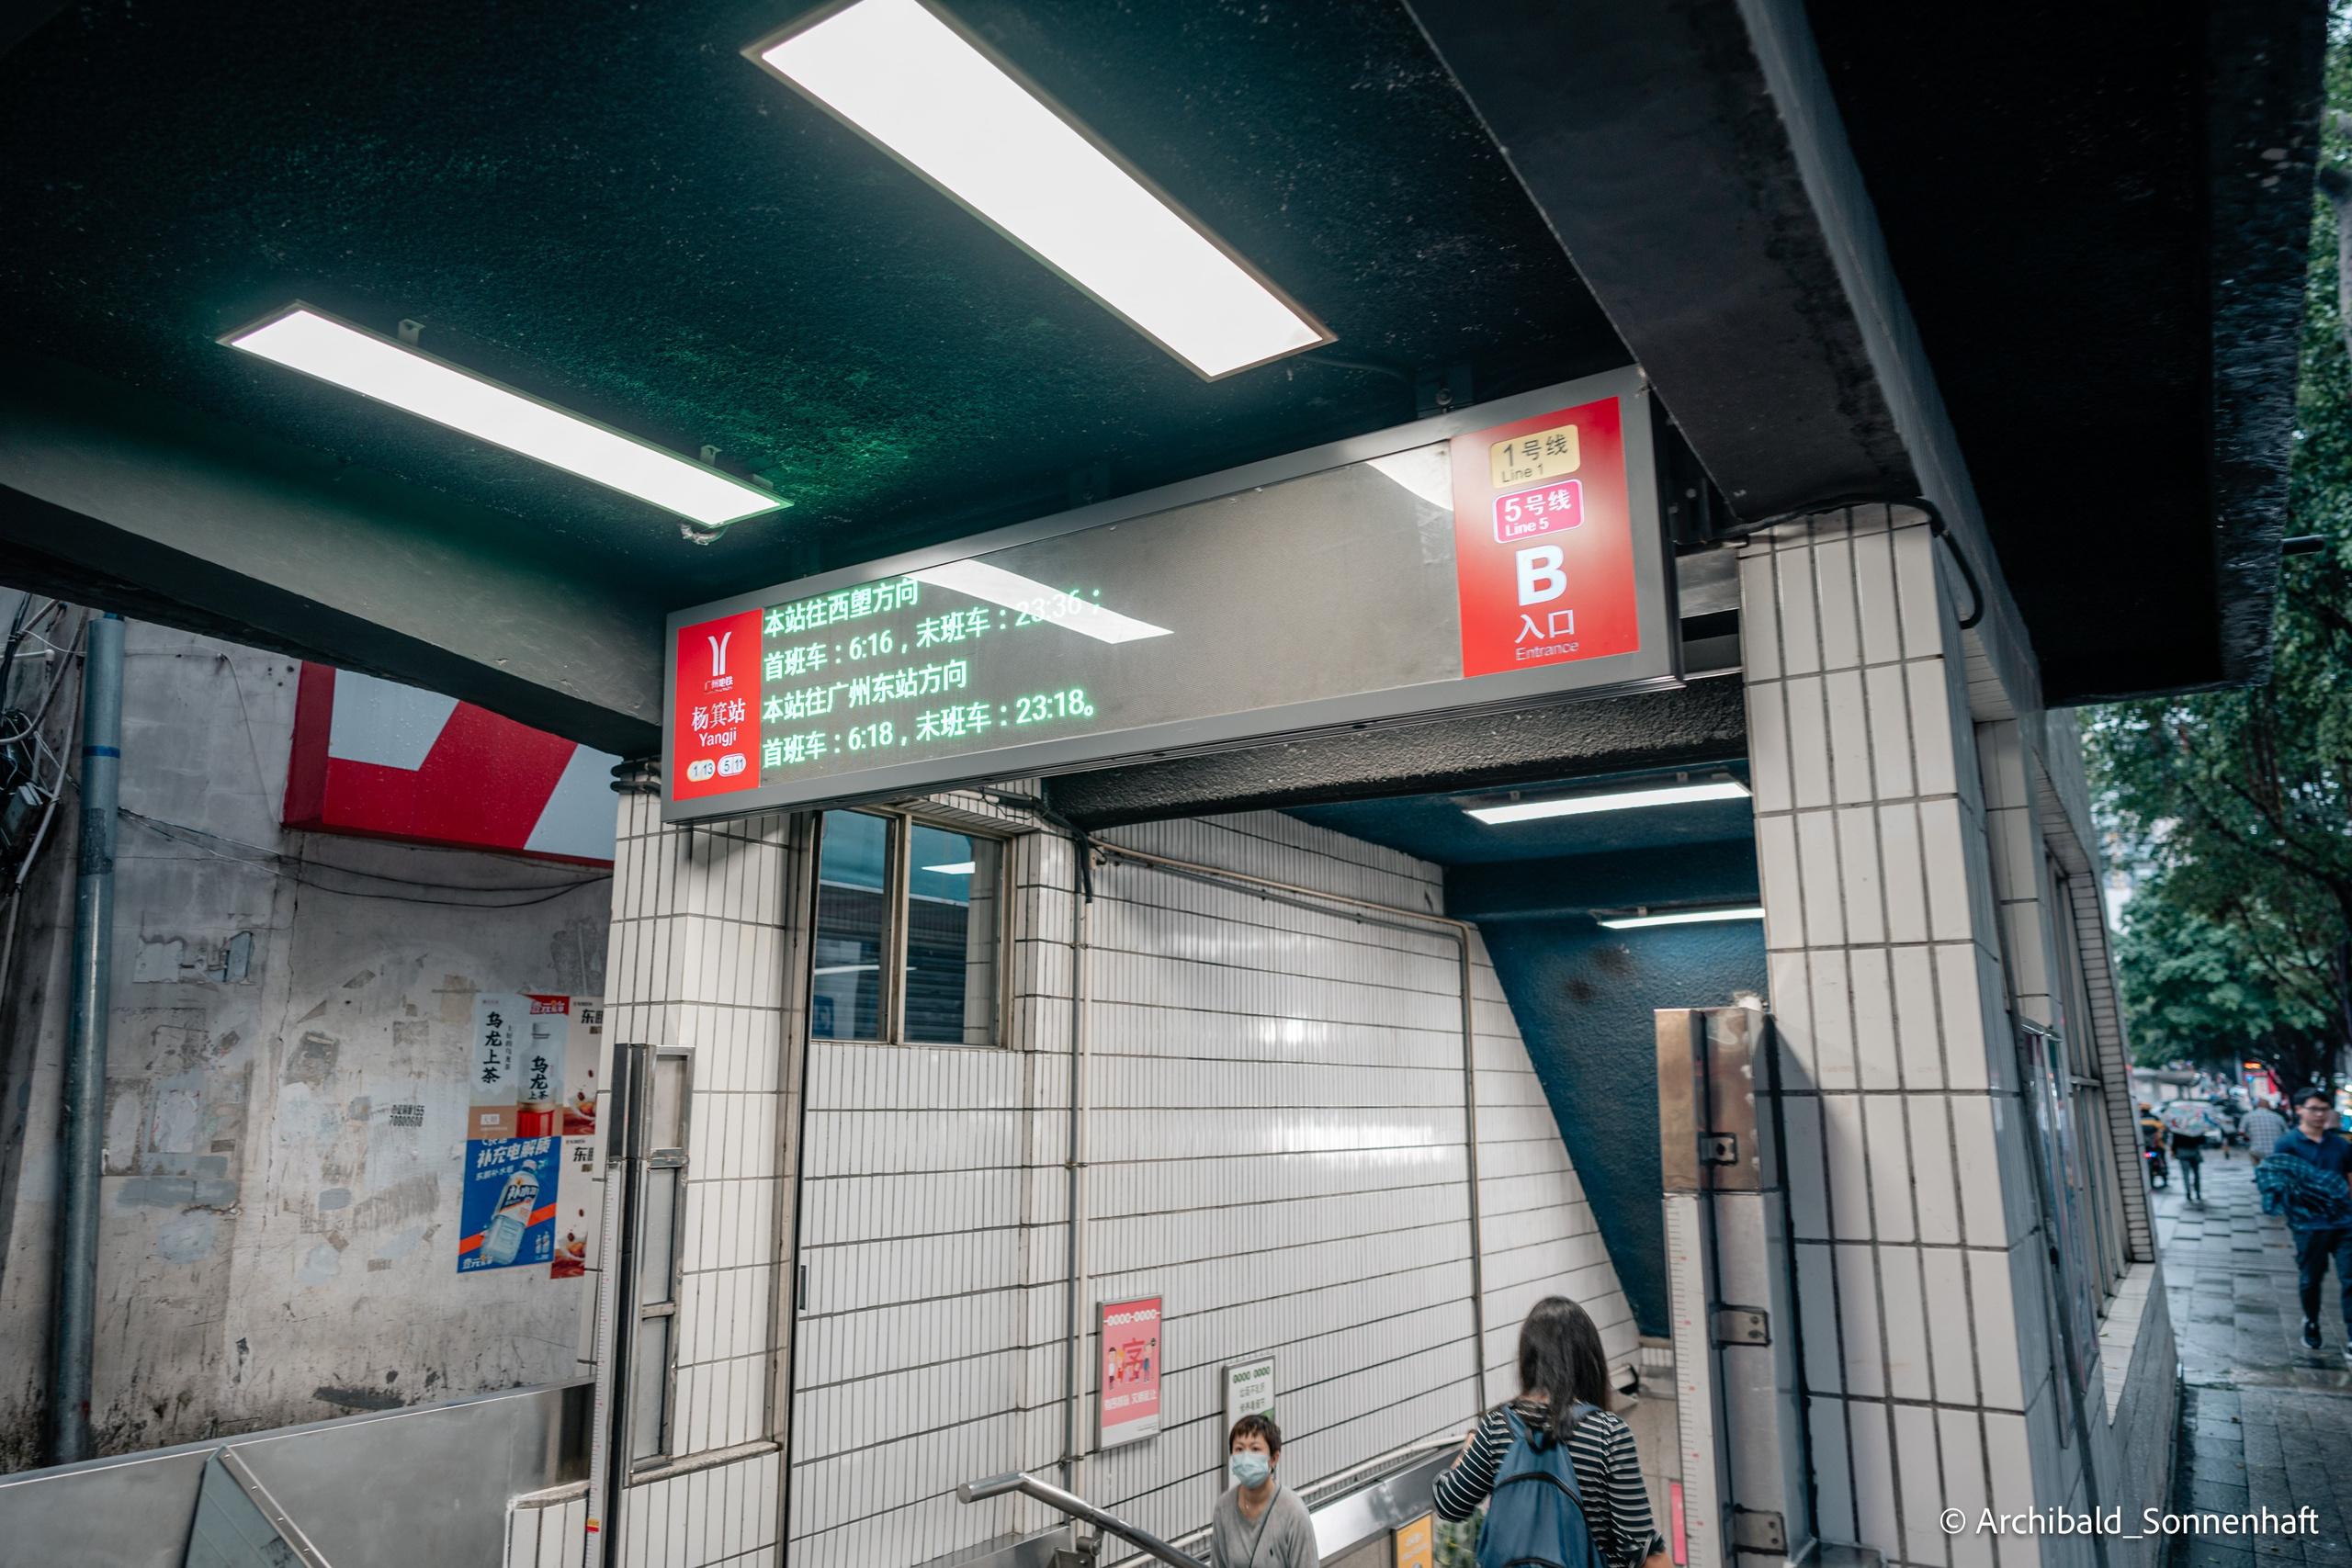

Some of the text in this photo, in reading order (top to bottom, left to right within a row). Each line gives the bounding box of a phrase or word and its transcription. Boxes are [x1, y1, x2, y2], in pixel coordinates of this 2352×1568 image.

[1502, 434, 1569, 468] 1号线
[1501, 464, 1544, 484] Line 1
[1504, 489, 1572, 523] 5号线
[1505, 516, 1550, 537] Line 5
[1516, 545, 1567, 607] B
[1514, 609, 1575, 644] 入口
[1515, 640, 1579, 661] Entrance
[763, 659, 967, 723] 本站往广州东站方向
[691, 697, 747, 732] 杨箕站
[698, 727, 737, 748] Yangji
[703, 762, 715, 775] 13
[723, 760, 730, 773] 5
[734, 758, 744, 771] 11
[481, 1011, 503, 1084] 乌龙上茶
[477, 1136, 551, 1168] 补充电解质
